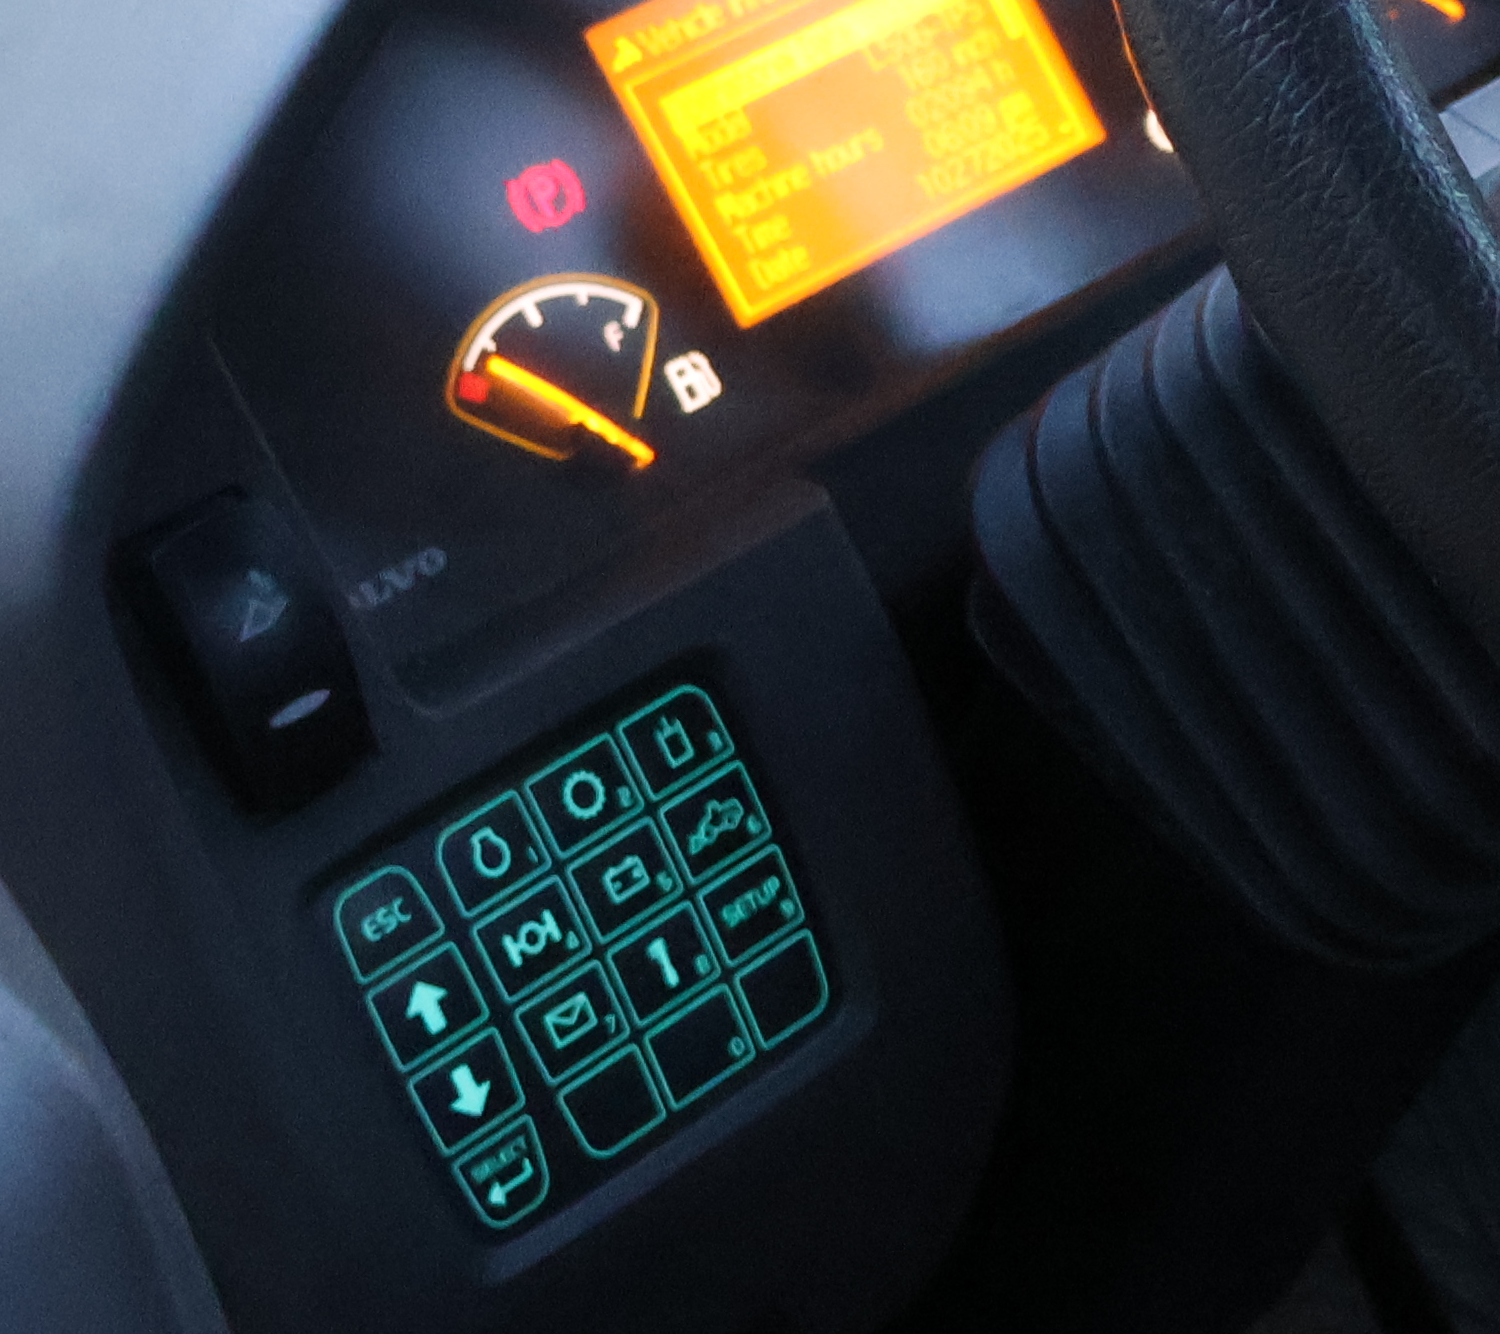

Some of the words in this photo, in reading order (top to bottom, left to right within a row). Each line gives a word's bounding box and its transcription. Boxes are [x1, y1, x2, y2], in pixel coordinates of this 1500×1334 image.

[812, 126, 882, 175] hours
[751, 242, 810, 287] Date
[361, 896, 412, 942] ESC
[721, 875, 781, 928] SETUP
